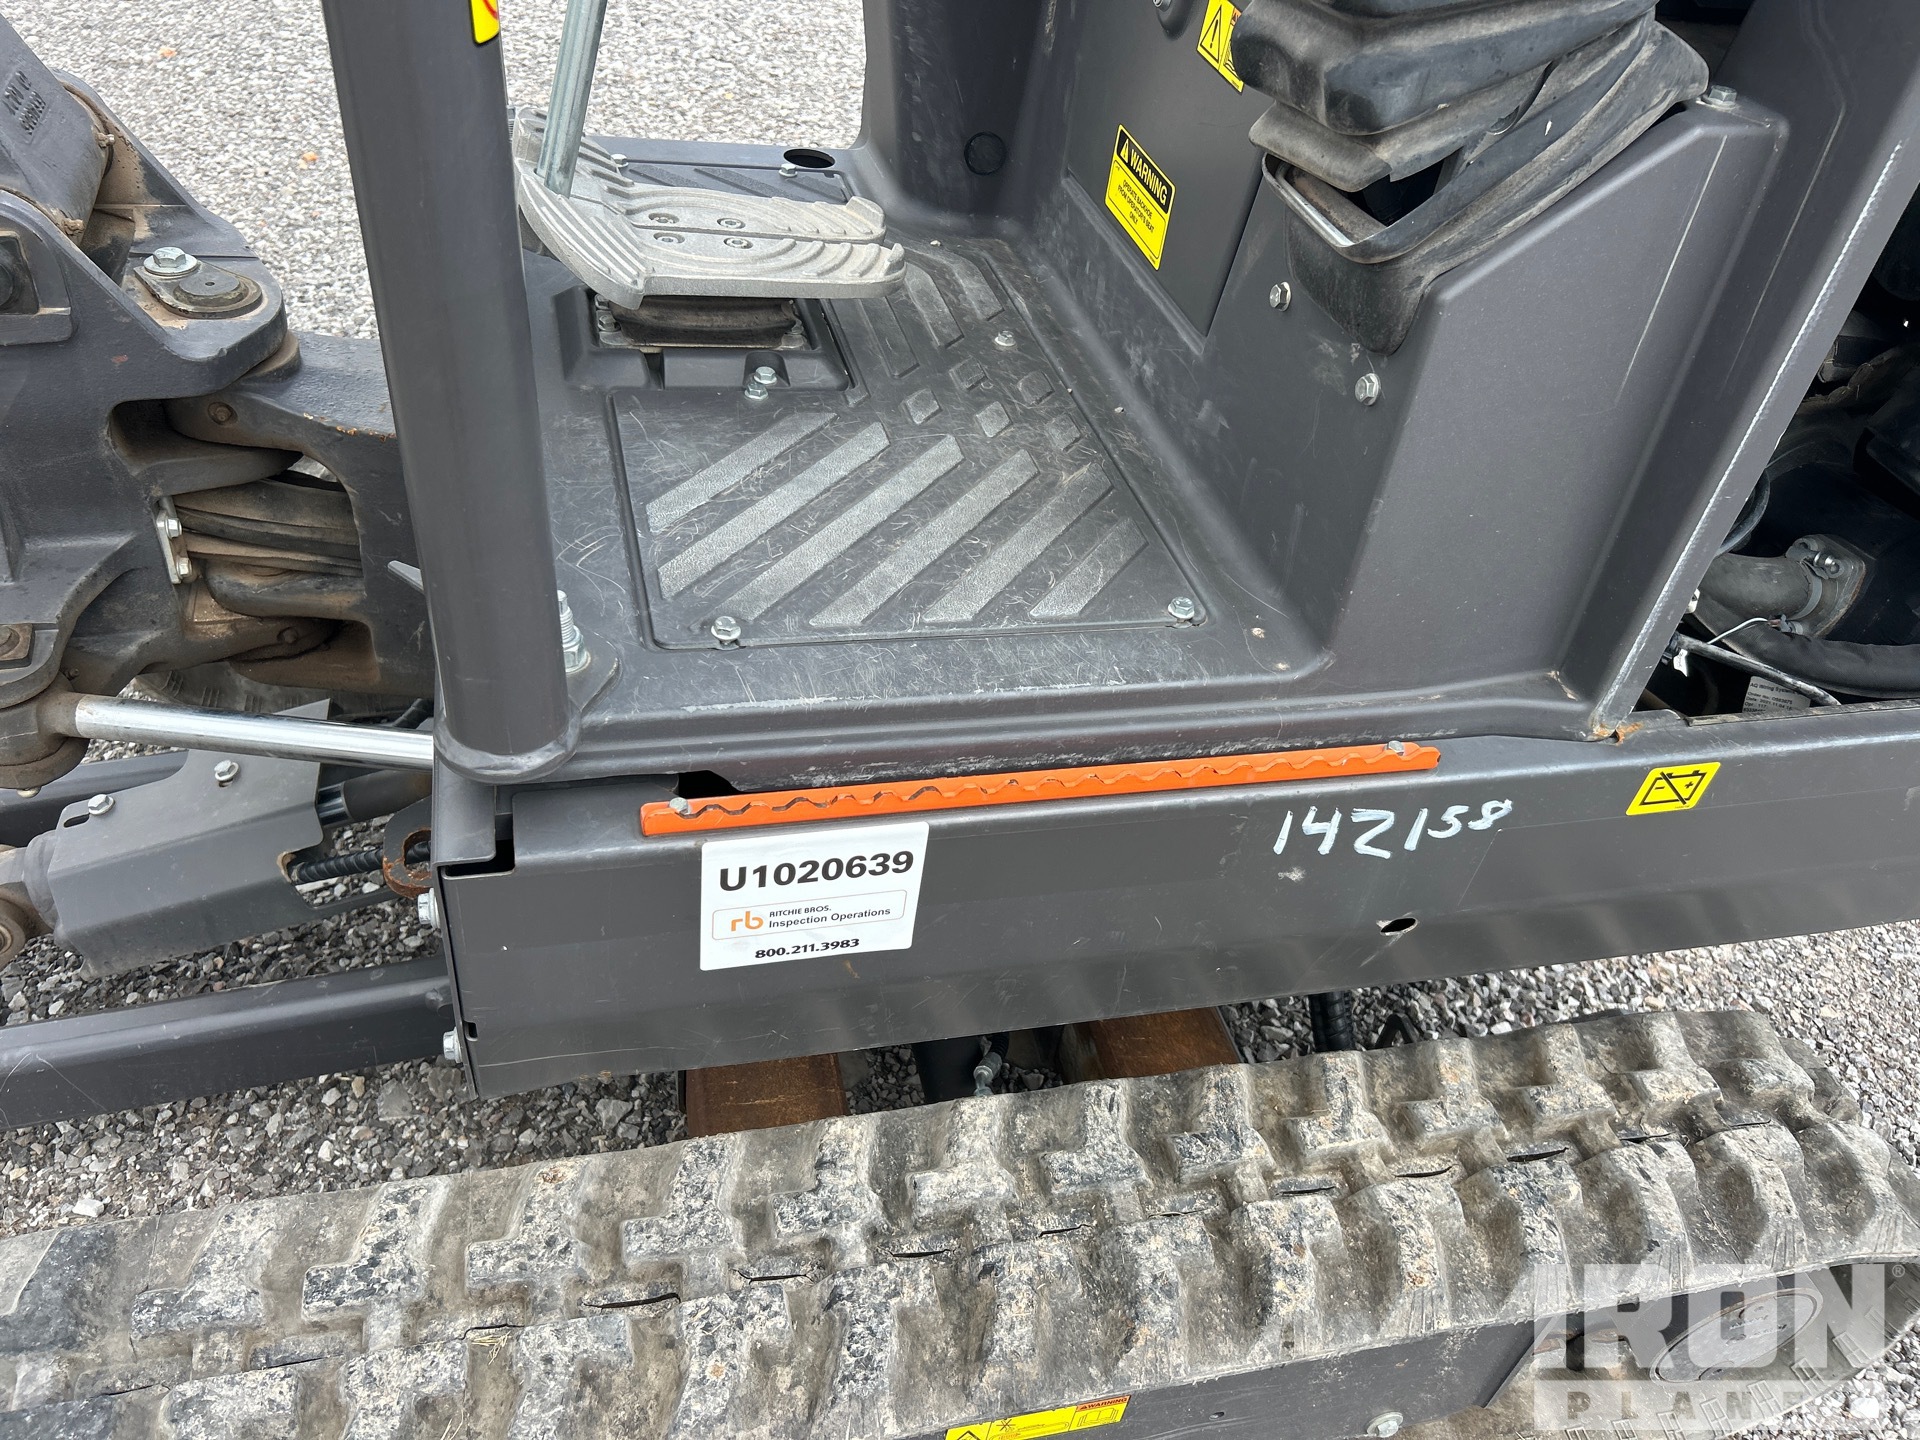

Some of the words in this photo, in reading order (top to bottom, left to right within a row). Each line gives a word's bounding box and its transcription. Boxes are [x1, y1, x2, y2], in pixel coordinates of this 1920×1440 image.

[1130, 148, 1168, 205] WARNING
[1273, 799, 1513, 859] 142158
[719, 850, 914, 892] U1020639
[731, 911, 764, 932] rb
[769, 907, 802, 918] RITCHIE
[804, 905, 832, 915] BROS.
[769, 914, 828, 929] Inspection
[831, 907, 891, 925] Operations
[755, 938, 860, 959] 800.211.3983
[1087, 1397, 1128, 1409] WARNING
